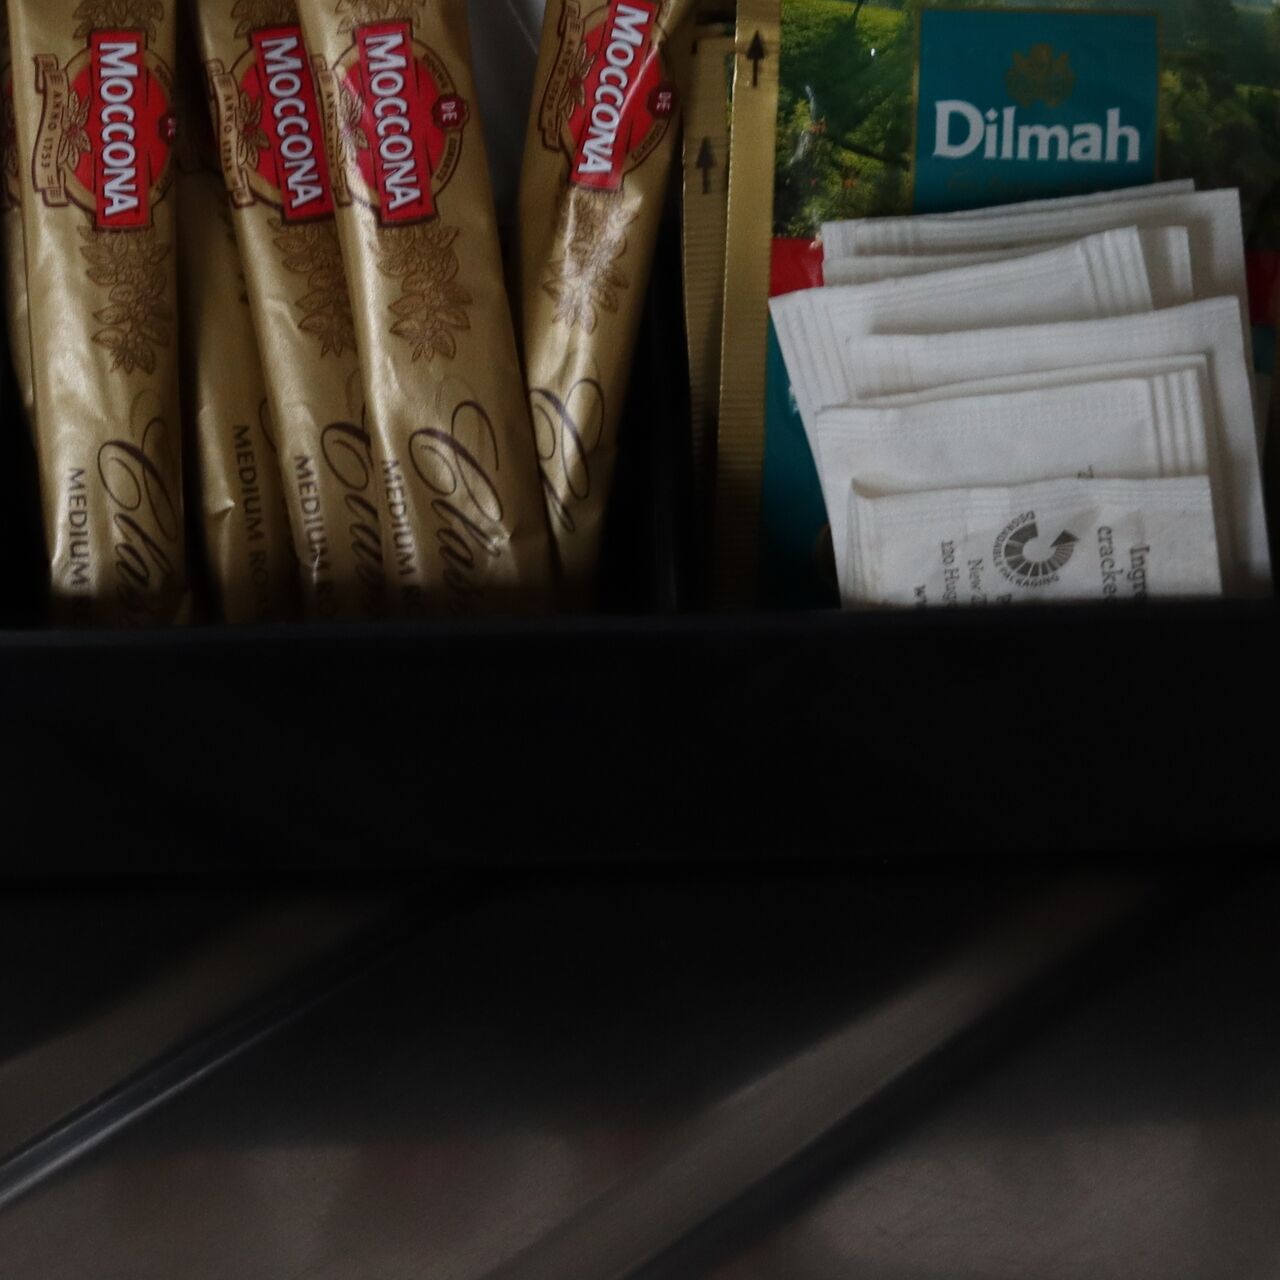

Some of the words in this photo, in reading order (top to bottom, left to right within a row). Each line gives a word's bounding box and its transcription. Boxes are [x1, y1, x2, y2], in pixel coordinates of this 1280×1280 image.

[98, 41, 139, 217] MOCCONA
[260, 35, 324, 209] MOCCONA
[364, 31, 422, 211] MOCCONA
[577, 2, 651, 174] MOCCONA
[931, 98, 1141, 163] Dilmah
[68, 467, 90, 586] MEDIUM
[231, 423, 266, 543] MEDIUM
